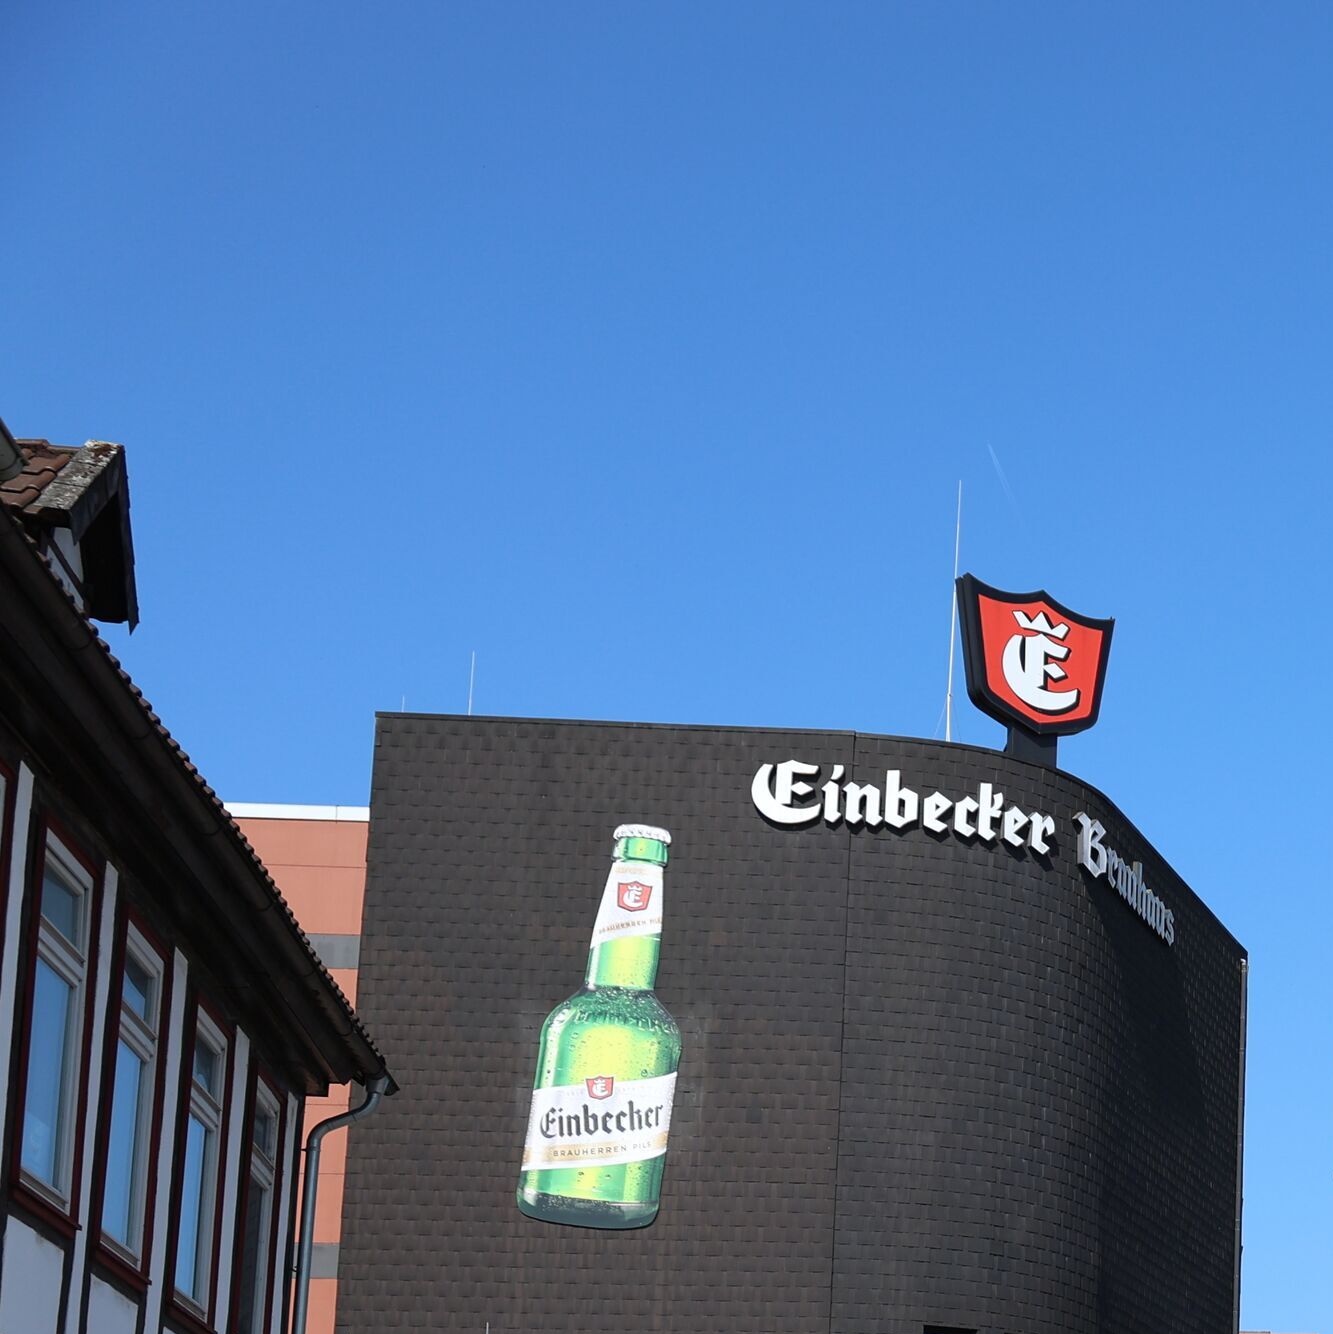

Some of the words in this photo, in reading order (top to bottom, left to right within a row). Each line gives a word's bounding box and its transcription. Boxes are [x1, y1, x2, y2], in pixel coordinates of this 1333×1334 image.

[751, 760, 1056, 855] Einbecker
[1072, 811, 1176, 946] Brauhaus
[540, 1100, 663, 1138] Einbecker
[552, 1144, 627, 1157] BRAUHERREN
[632, 1141, 652, 1150] PILS
